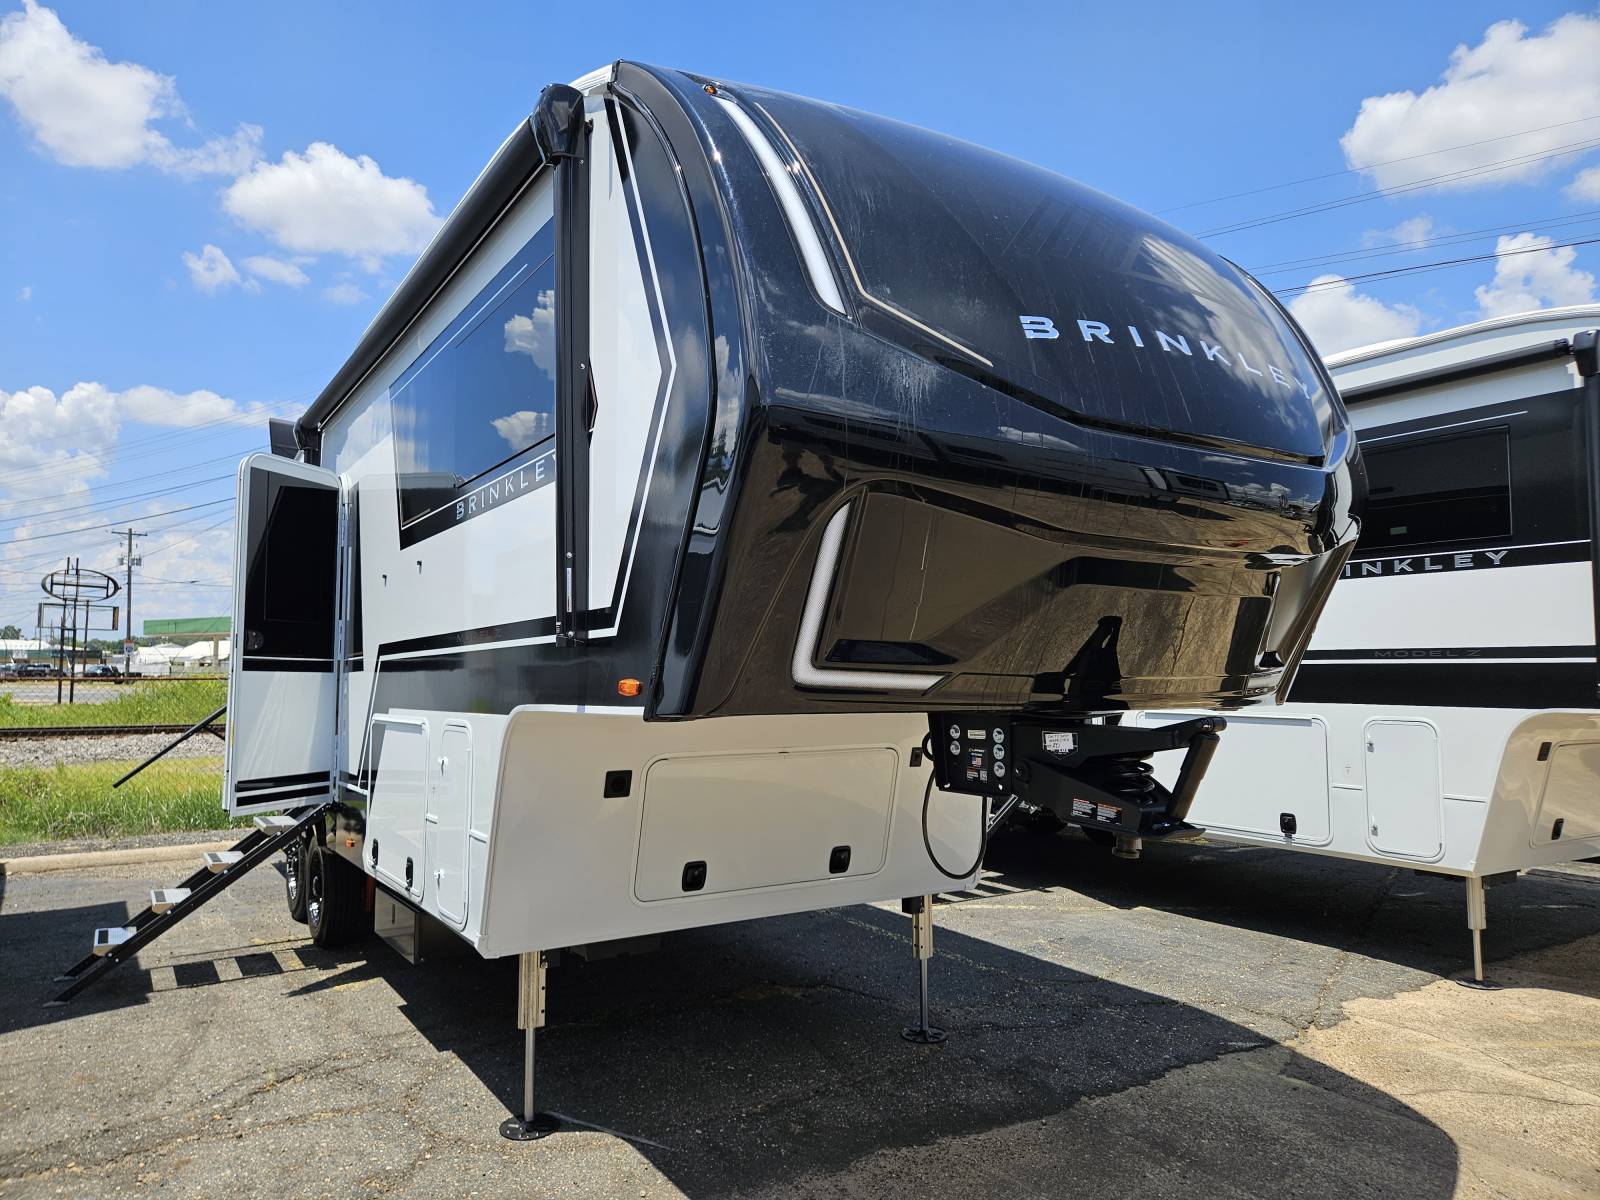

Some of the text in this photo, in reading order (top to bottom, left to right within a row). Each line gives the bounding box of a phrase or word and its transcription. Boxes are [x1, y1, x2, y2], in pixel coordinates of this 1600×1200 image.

[1019, 314, 1311, 400] BRINKLEY
[456, 452, 556, 520] BRINKLE
[1345, 550, 1508, 578] INKLEY
[1374, 649, 1482, 658] MODEL Z
